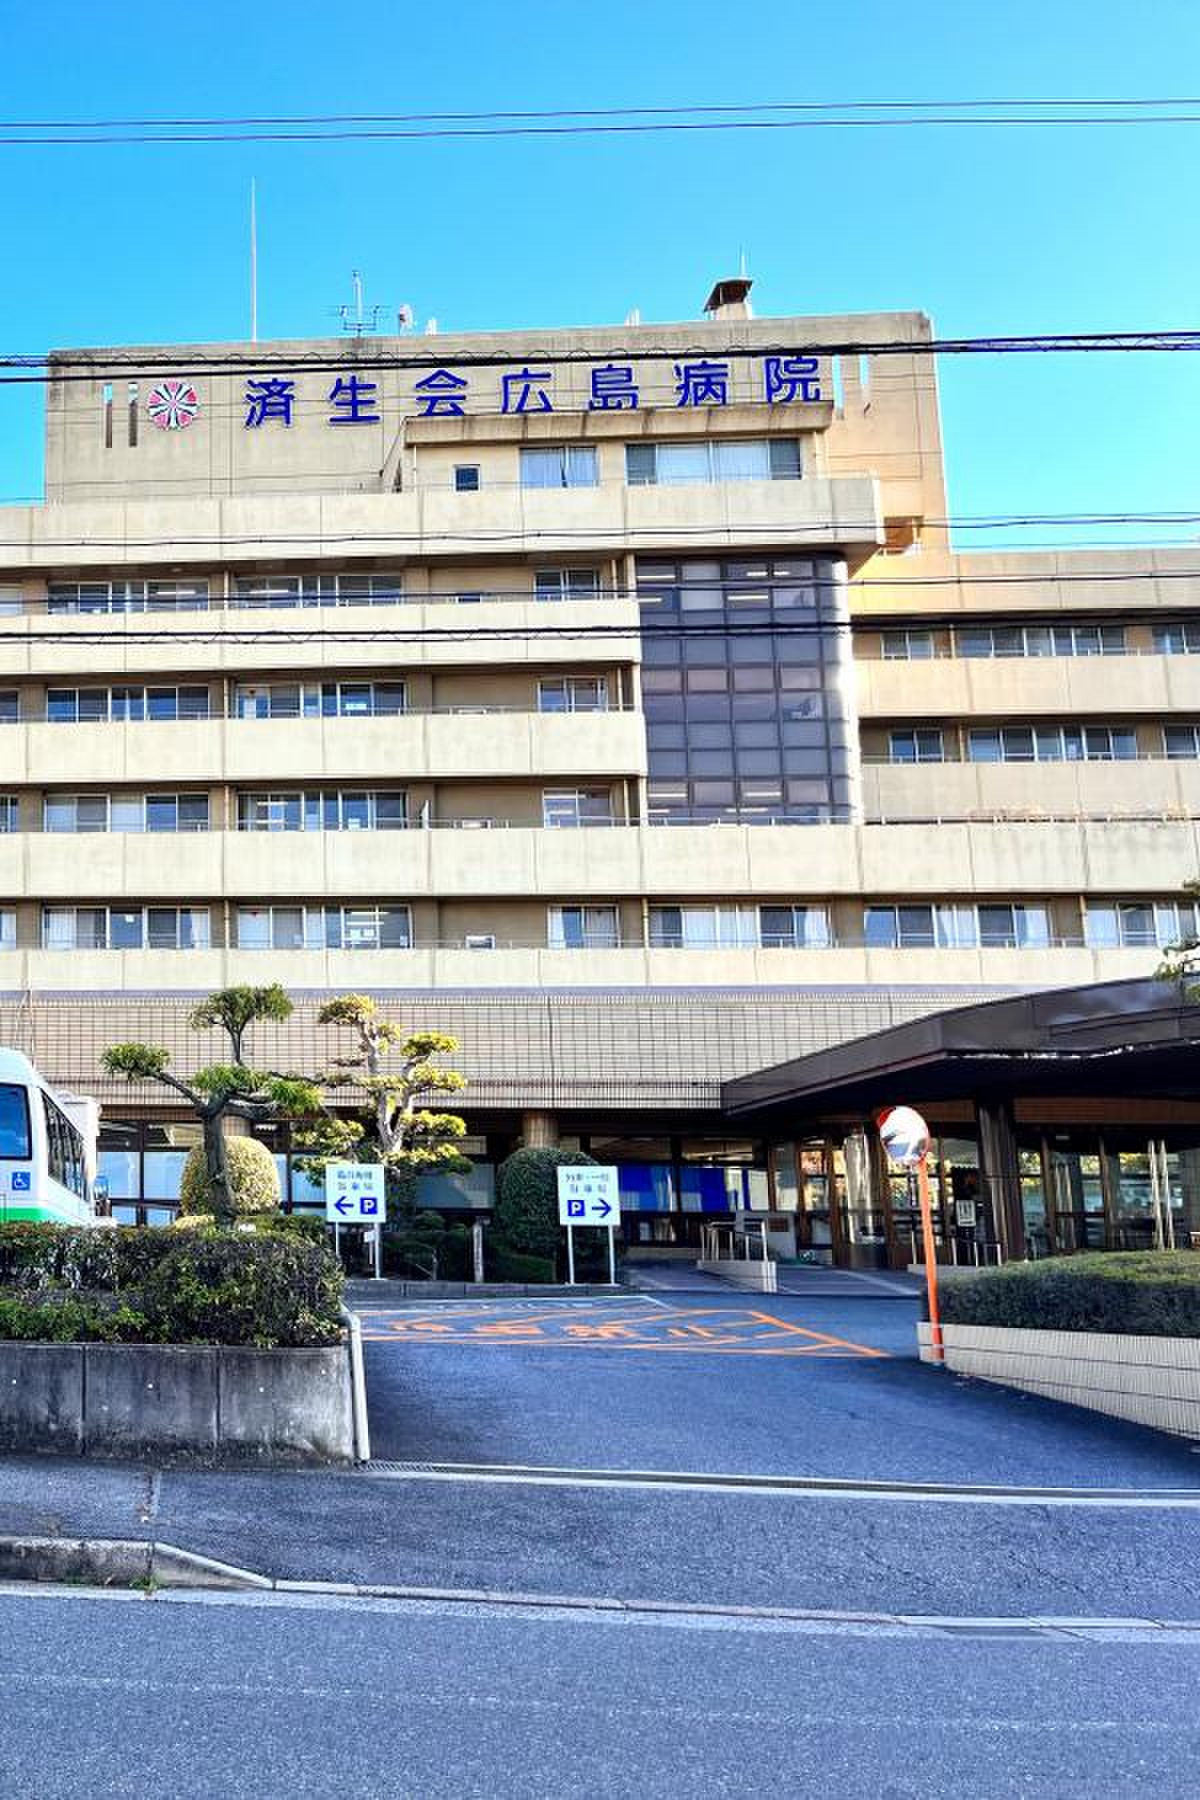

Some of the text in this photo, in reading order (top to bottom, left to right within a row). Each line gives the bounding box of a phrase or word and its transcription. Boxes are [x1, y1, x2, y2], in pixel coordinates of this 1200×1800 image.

[245, 357, 822, 428] 済生会広島病院
[362, 1198, 377, 1214] P
[569, 1200, 584, 1216] P
